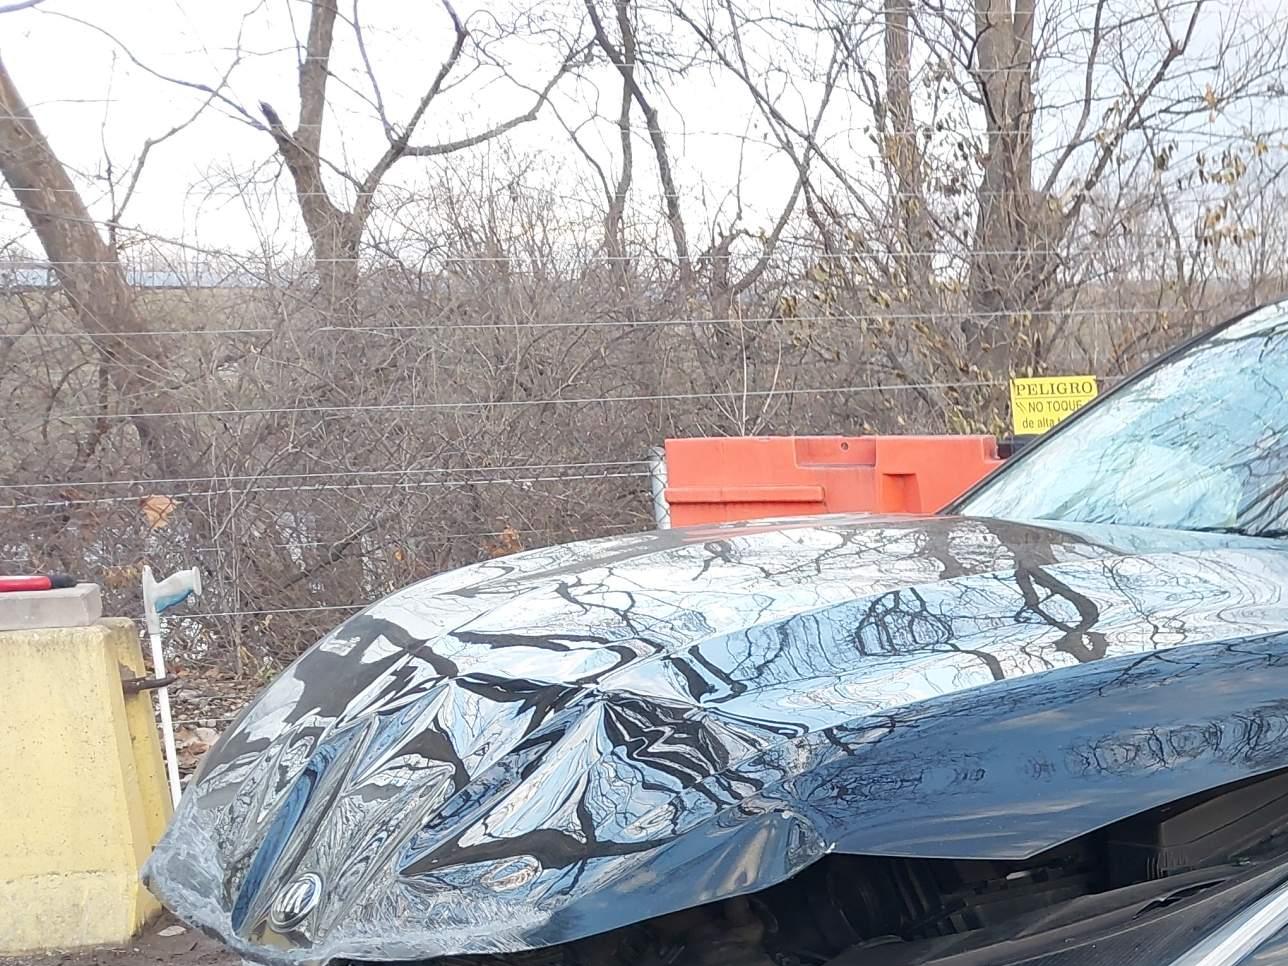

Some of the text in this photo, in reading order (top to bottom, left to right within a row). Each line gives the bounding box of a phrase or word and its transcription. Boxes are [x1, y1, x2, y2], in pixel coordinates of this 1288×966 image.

[1016, 381, 1093, 396] PELIGRO
[1028, 401, 1043, 413] NO
[1022, 418, 1034, 429] de
[1038, 417, 1055, 428] alta
